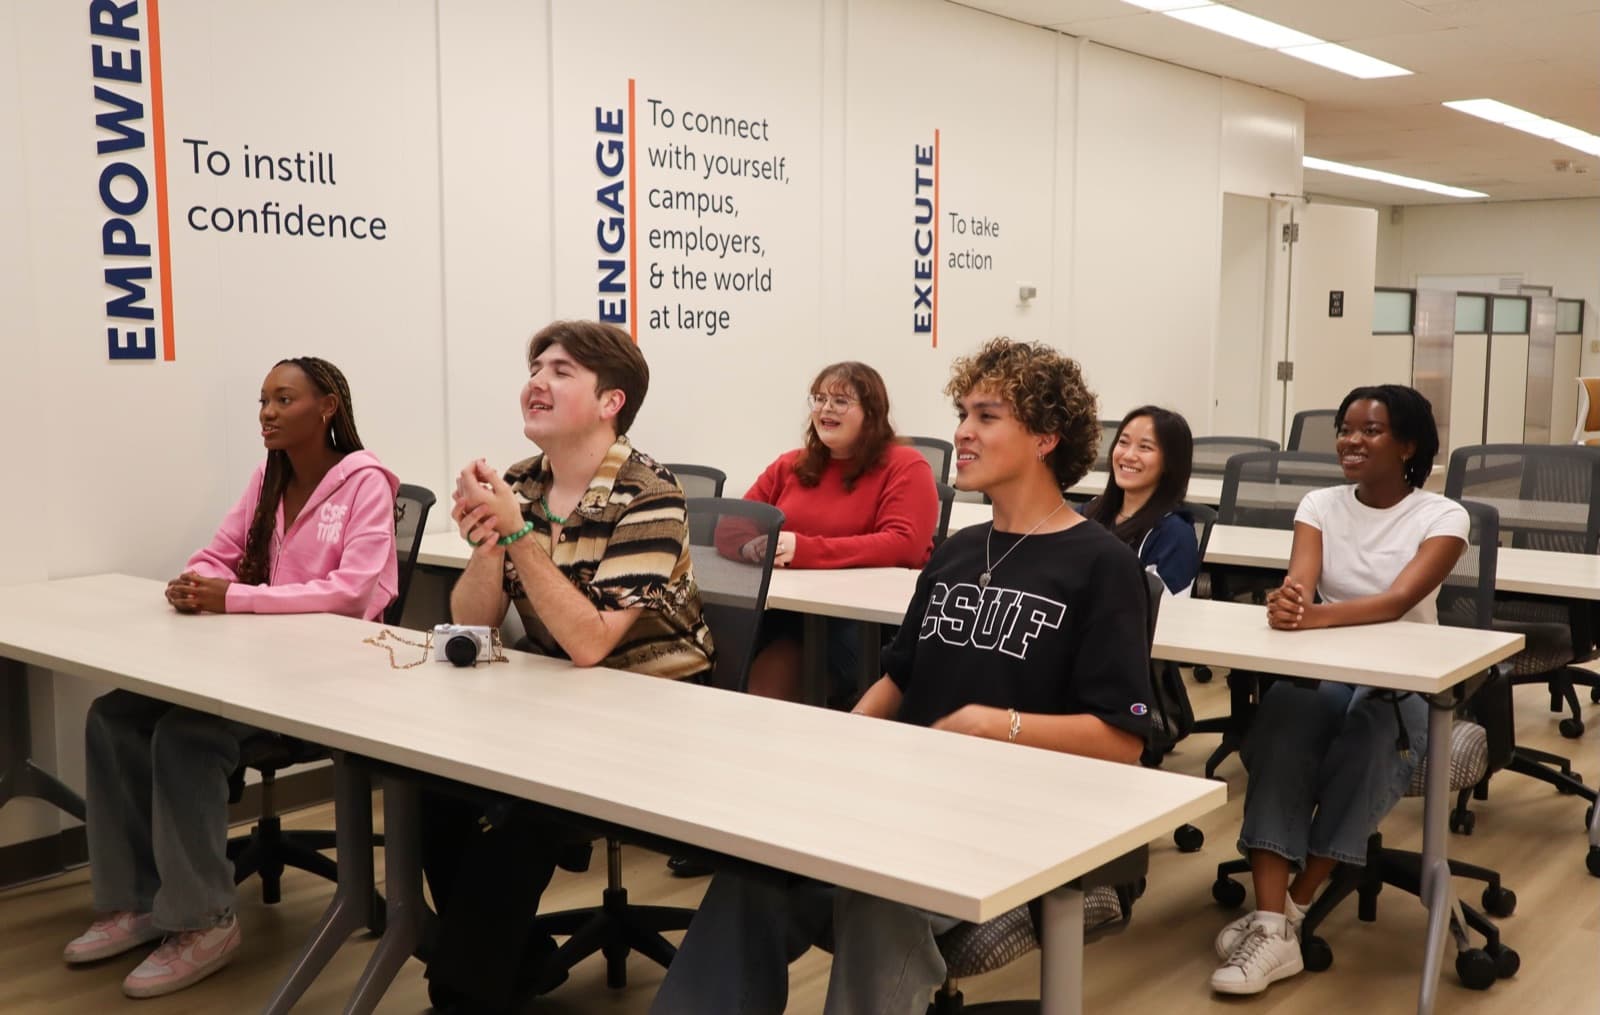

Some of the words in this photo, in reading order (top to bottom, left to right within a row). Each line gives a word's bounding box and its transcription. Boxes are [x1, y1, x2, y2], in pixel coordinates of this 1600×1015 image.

[648, 99, 675, 128] To
[682, 110, 769, 142] connect
[89, 0, 156, 360] EMPOWER
[183, 138, 230, 176] To
[243, 144, 337, 185] instill
[648, 143, 696, 171] with
[703, 151, 790, 185] yourself,
[187, 202, 387, 241] confidence
[595, 107, 626, 324] ENGAGE
[648, 187, 739, 218] campus,
[648, 226, 766, 257] employers,
[914, 144, 934, 333] EXECUTE
[948, 212, 967, 235] To
[970, 215, 1000, 238] take
[649, 263, 665, 289] &
[671, 264, 708, 290] the
[713, 266, 772, 292] world
[948, 249, 993, 270] action
[649, 305, 671, 329] at
[677, 303, 731, 336] large
[919, 582, 1067, 659] CSUF
